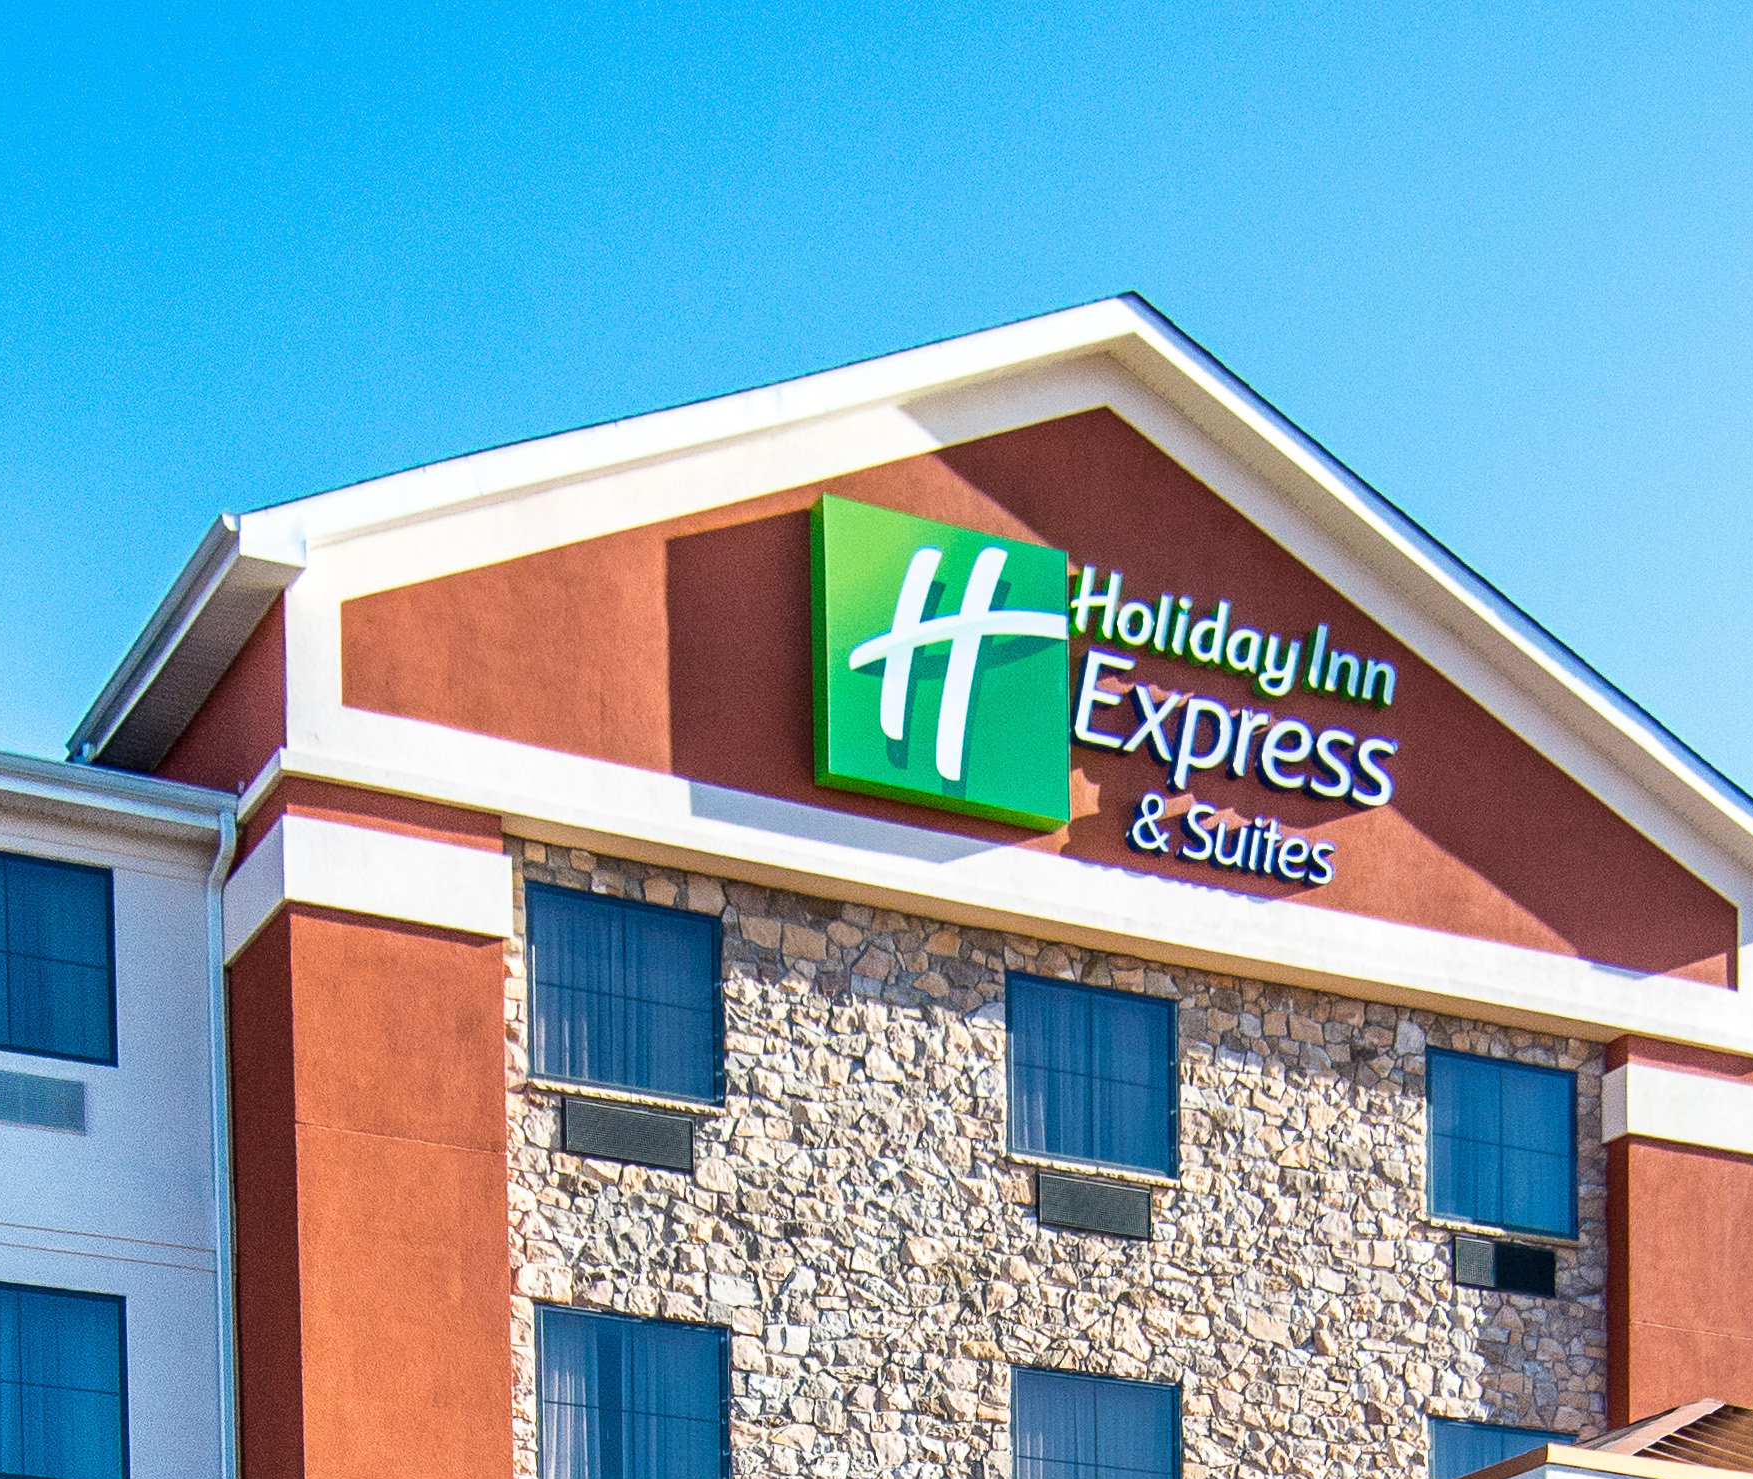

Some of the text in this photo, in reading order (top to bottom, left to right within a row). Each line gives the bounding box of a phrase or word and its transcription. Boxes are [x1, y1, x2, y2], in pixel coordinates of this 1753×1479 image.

[1071, 565, 1397, 707] Holiday Inn
[1073, 650, 1399, 807] Express
[1130, 792, 1337, 886] & Suites
